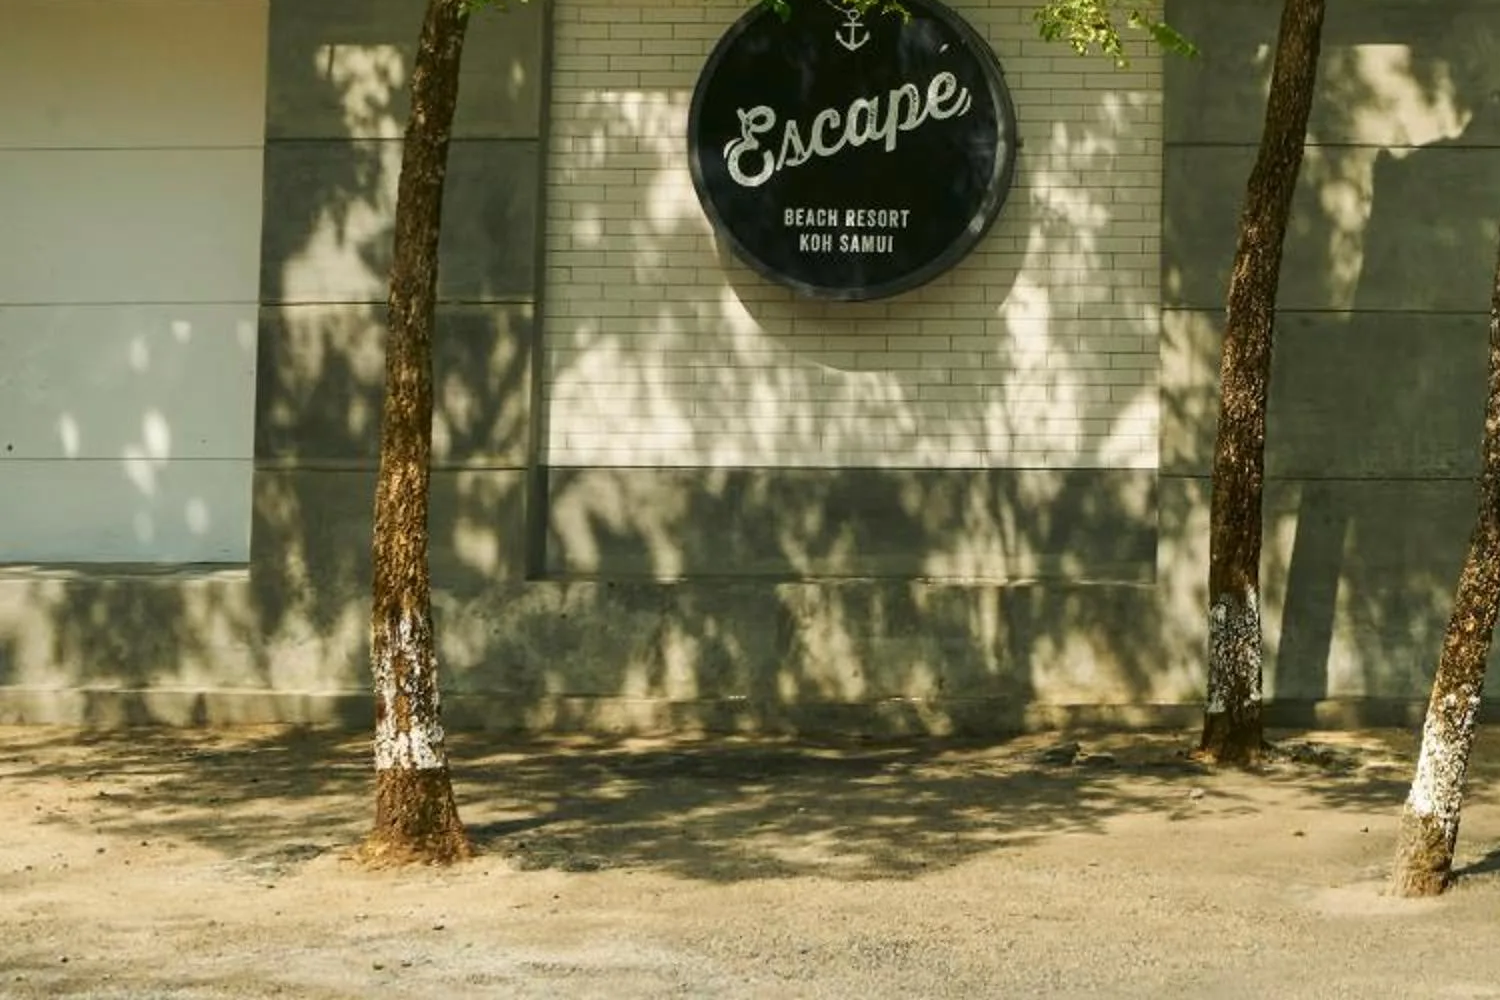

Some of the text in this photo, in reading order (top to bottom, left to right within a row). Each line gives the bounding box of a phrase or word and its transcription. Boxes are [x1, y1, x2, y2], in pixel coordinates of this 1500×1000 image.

[723, 71, 972, 187] Escape
[784, 207, 910, 228] BEACH RESORT
[800, 233, 894, 253] KOH SAMUI
